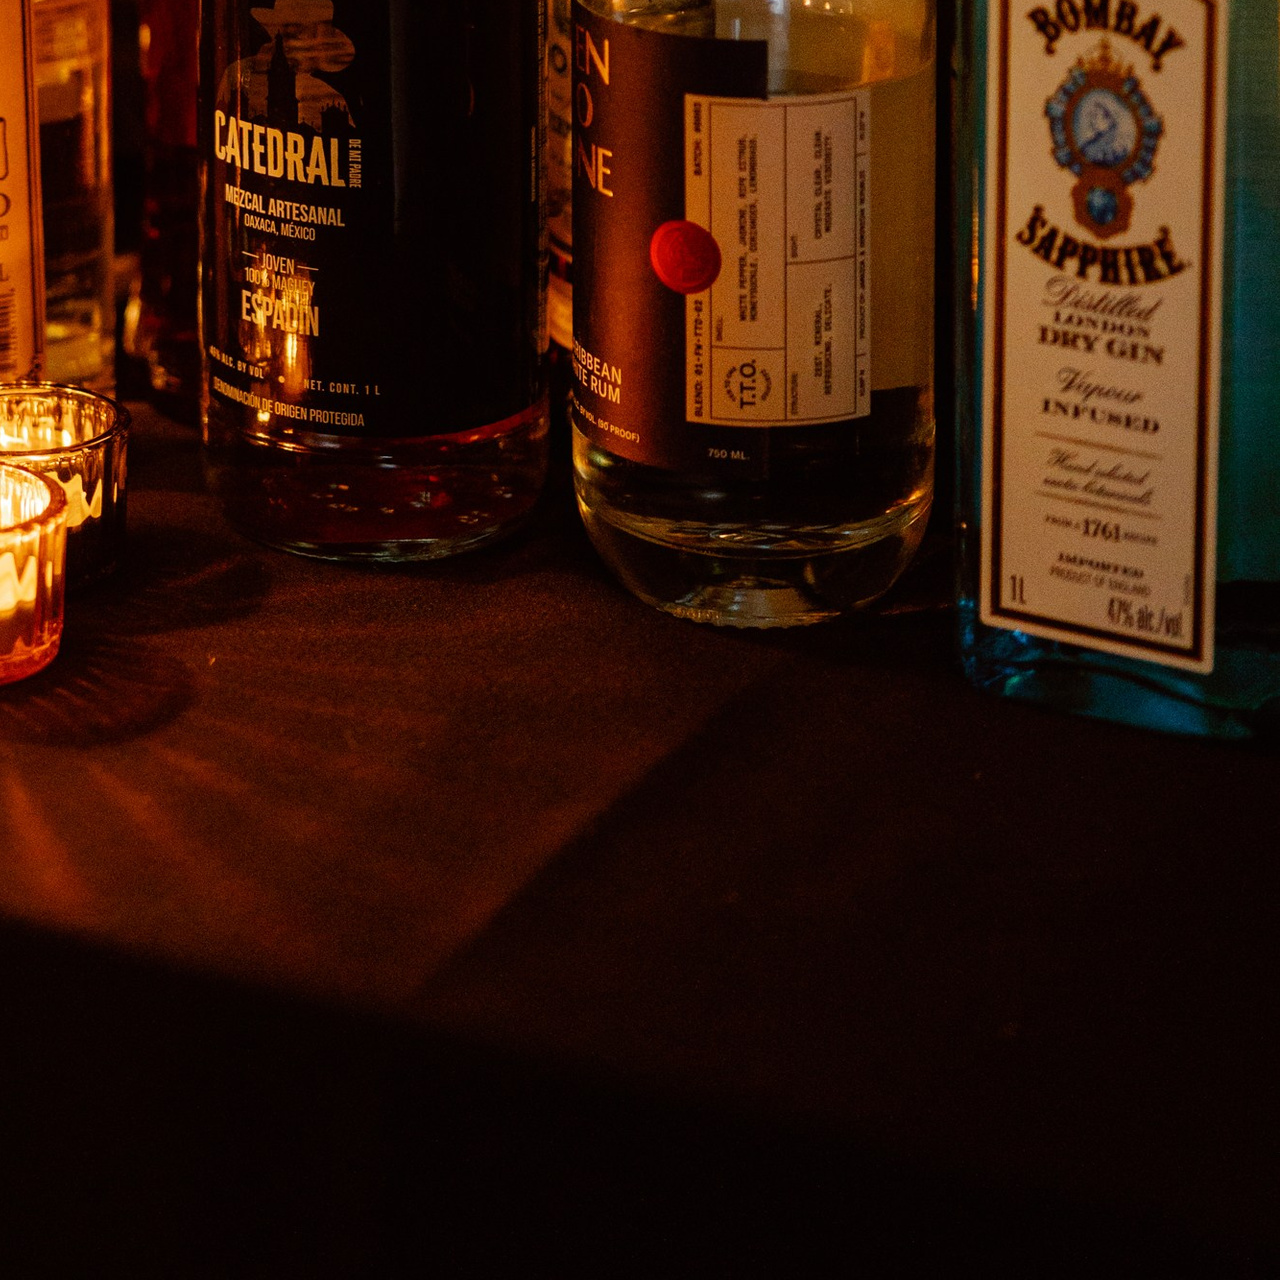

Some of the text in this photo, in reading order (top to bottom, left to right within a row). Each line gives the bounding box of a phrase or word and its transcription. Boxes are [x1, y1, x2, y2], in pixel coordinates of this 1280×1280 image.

[214, 109, 347, 188] CATEDRAL
[348, 138, 362, 189] DE MI PADRE
[225, 183, 345, 227] MEZCAL ARTESANAL
[243, 212, 316, 241] OAXACA, MÉXICO
[1016, 203, 1192, 286] SAPPHIRE
[244, 266, 316, 296] 100% MAGUEY
[261, 252, 295, 275] JOVEN
[1041, 275, 1164, 321] Distilled
[1053, 310, 1150, 339] LONDON
[1037, 324, 1166, 367] DRY GIN
[213, 375, 365, 427] DENOMINACIÓN DE ORIGEN PROTEGIDA
[303, 378, 325, 392] NET.
[329, 381, 360, 395] CONT.
[374, 384, 382, 396] L
[590, 374, 621, 405] RUM
[693, 380, 704, 418] BLEND:
[739, 359, 756, 409] T.T.O.
[609, 424, 641, 444] PROOF)
[1042, 396, 1161, 435] INFUSED
[707, 446, 728, 459] 750
[1083, 517, 1121, 543] 1761
